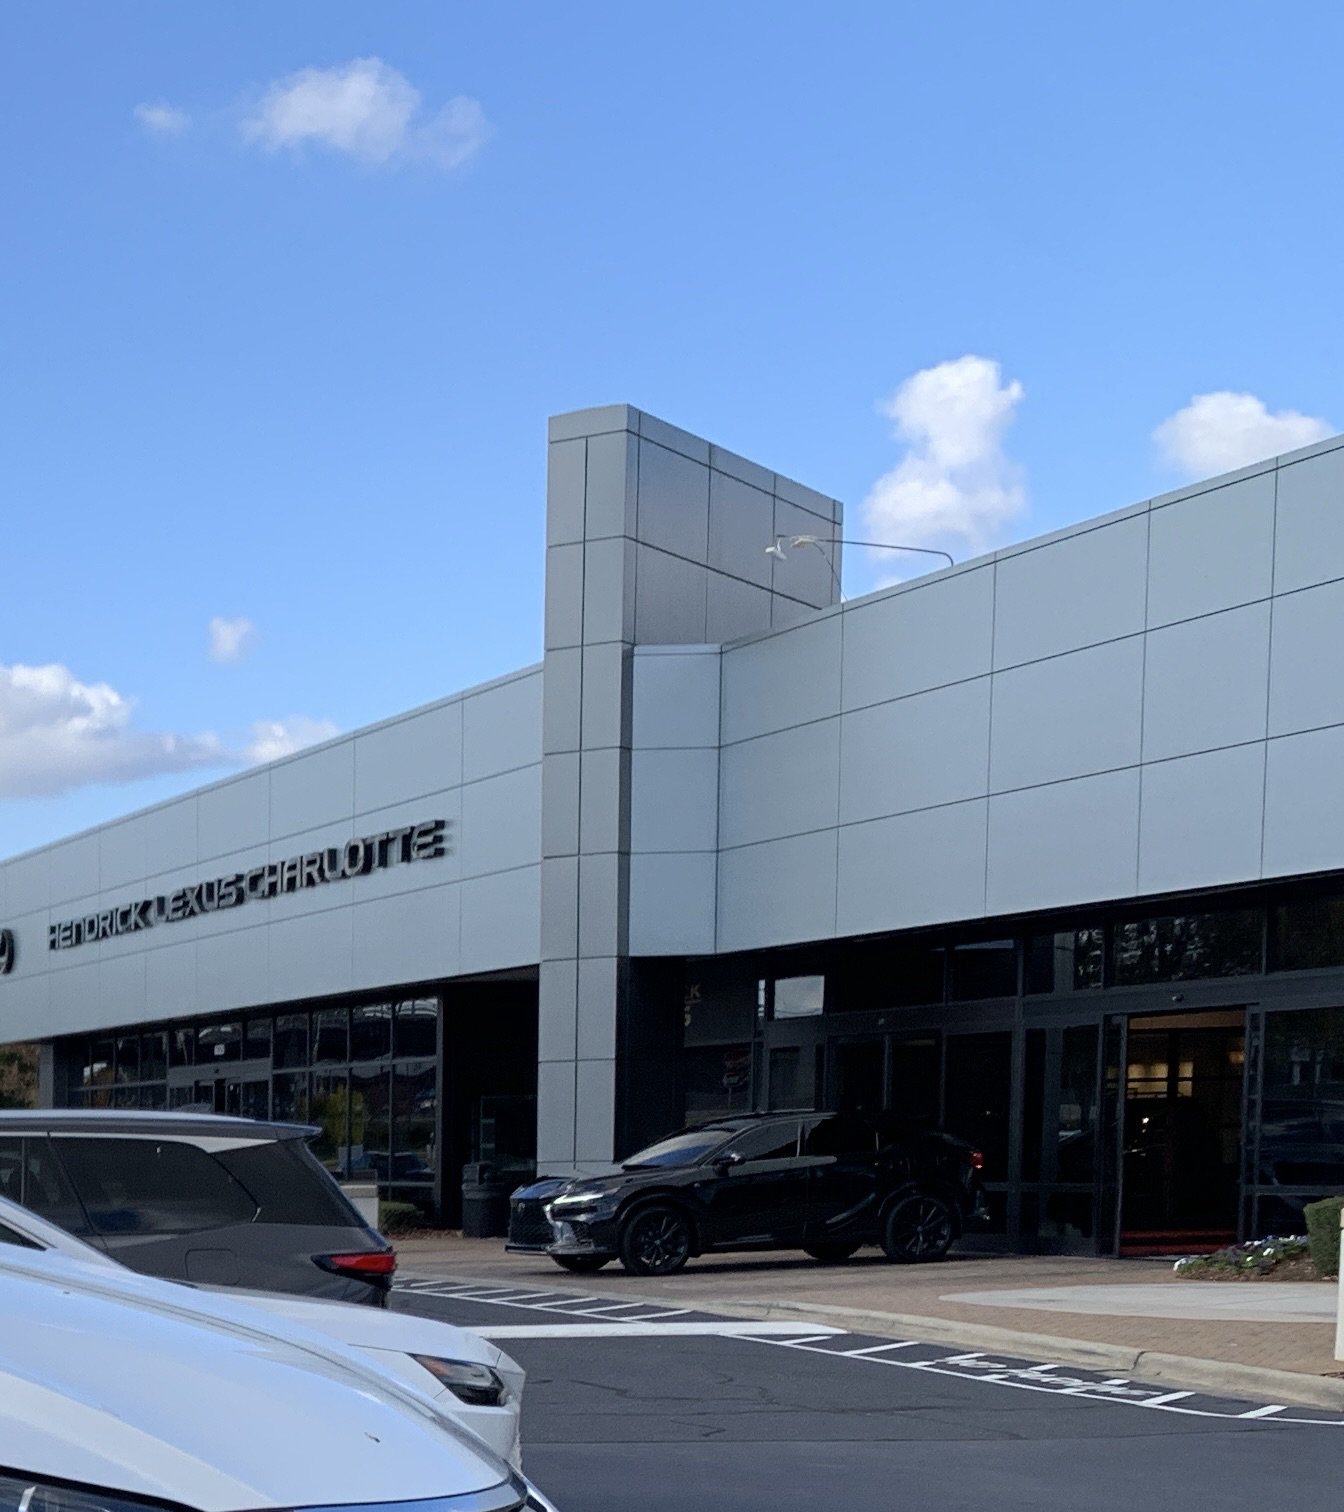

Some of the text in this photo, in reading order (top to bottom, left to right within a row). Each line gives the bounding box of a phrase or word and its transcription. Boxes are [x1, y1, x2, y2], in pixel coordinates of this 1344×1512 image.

[48, 819, 446, 951] HENDRICK LEXUS CHARLOTTE
